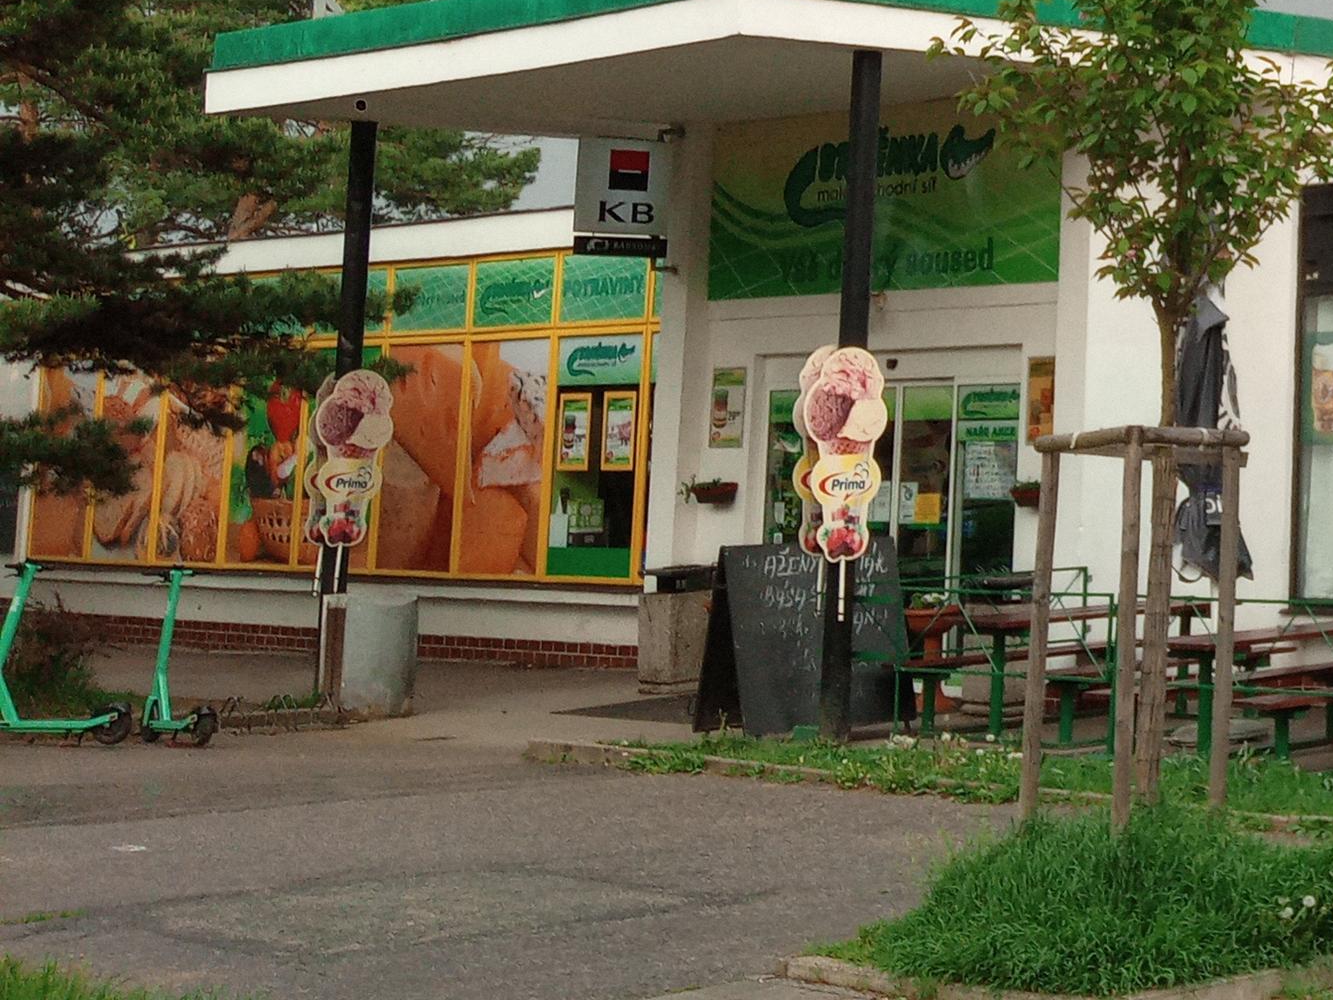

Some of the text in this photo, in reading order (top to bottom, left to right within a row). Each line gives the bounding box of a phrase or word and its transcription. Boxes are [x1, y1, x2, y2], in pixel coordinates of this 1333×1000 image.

[599, 200, 654, 224] KB
[335, 478, 368, 490] Prima
[831, 478, 865, 491] Prima
